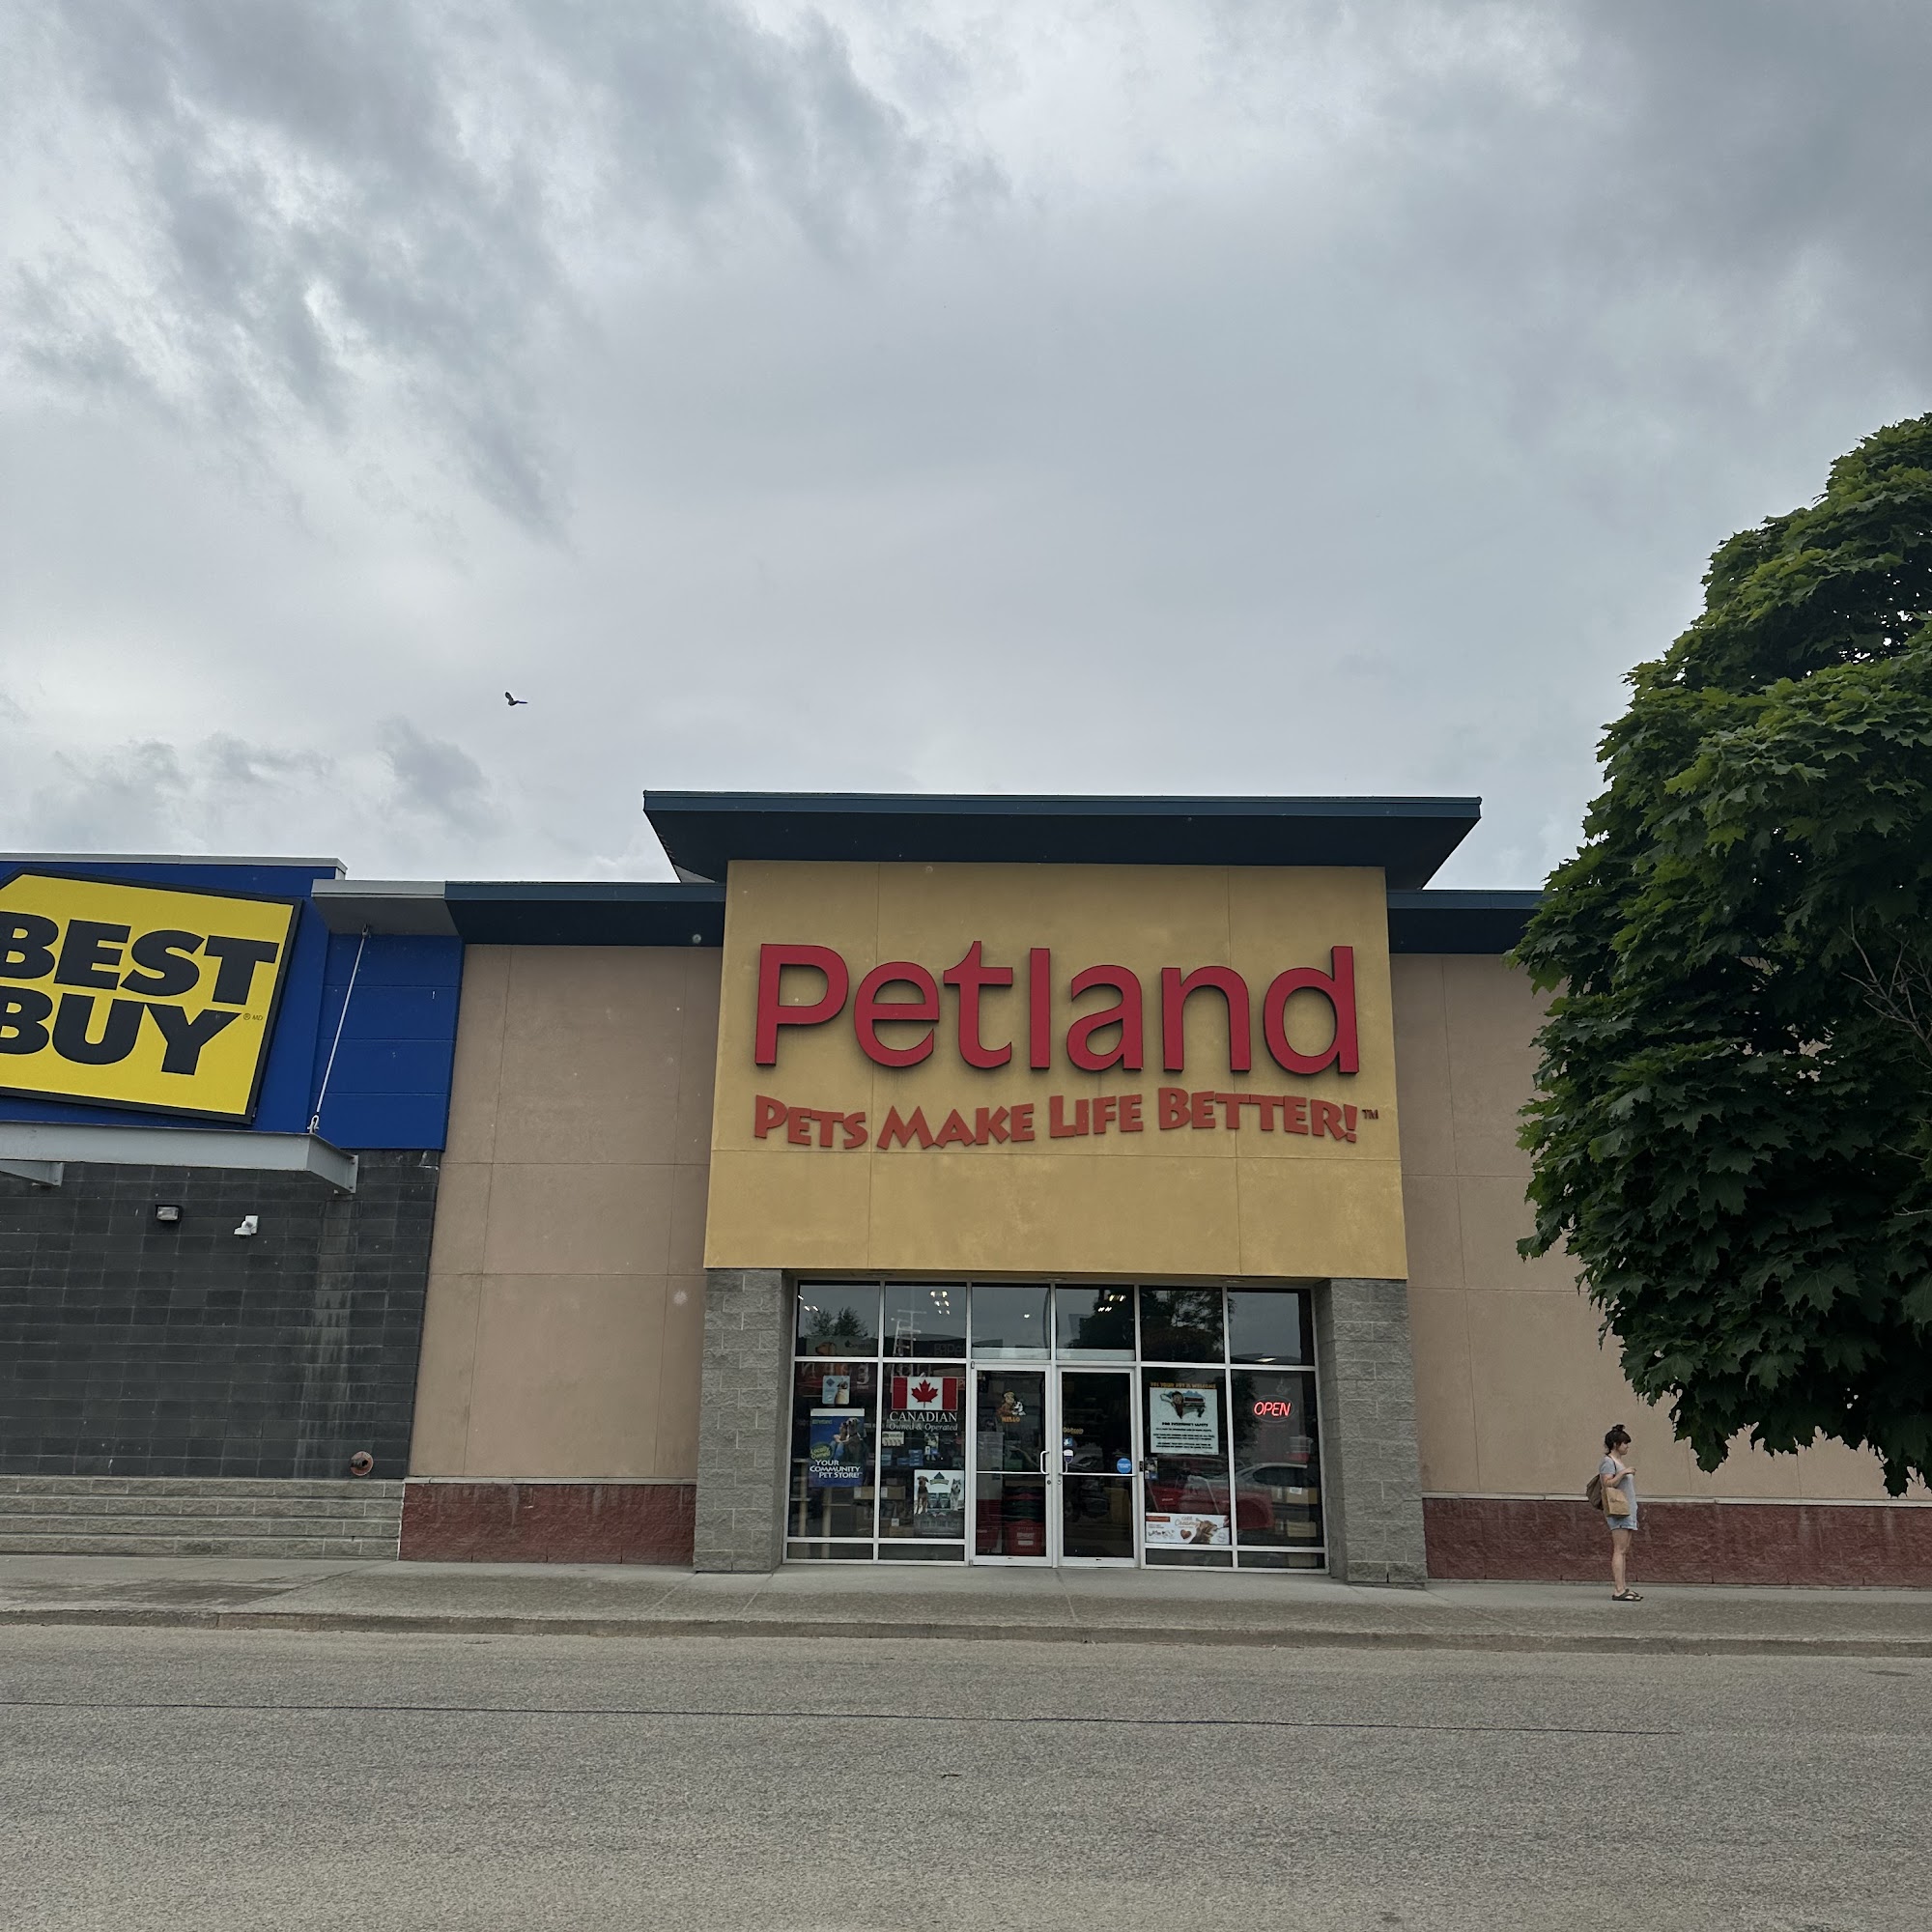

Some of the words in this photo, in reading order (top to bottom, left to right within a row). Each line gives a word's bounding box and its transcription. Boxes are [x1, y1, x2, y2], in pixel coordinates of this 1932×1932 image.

[0, 910, 280, 1006] BEST
[0, 985, 242, 1076] BUY
[754, 940, 1359, 1075] Petland
[754, 1094, 868, 1150] PETS
[876, 1103, 1035, 1151] MAKE
[1049, 1094, 1143, 1139] LIFE
[1158, 1087, 1358, 1144] BETTER!
[890, 1411, 957, 1422] CANADIAN
[924, 1423, 959, 1432] Operated
[1254, 1401, 1292, 1417] OPEN
